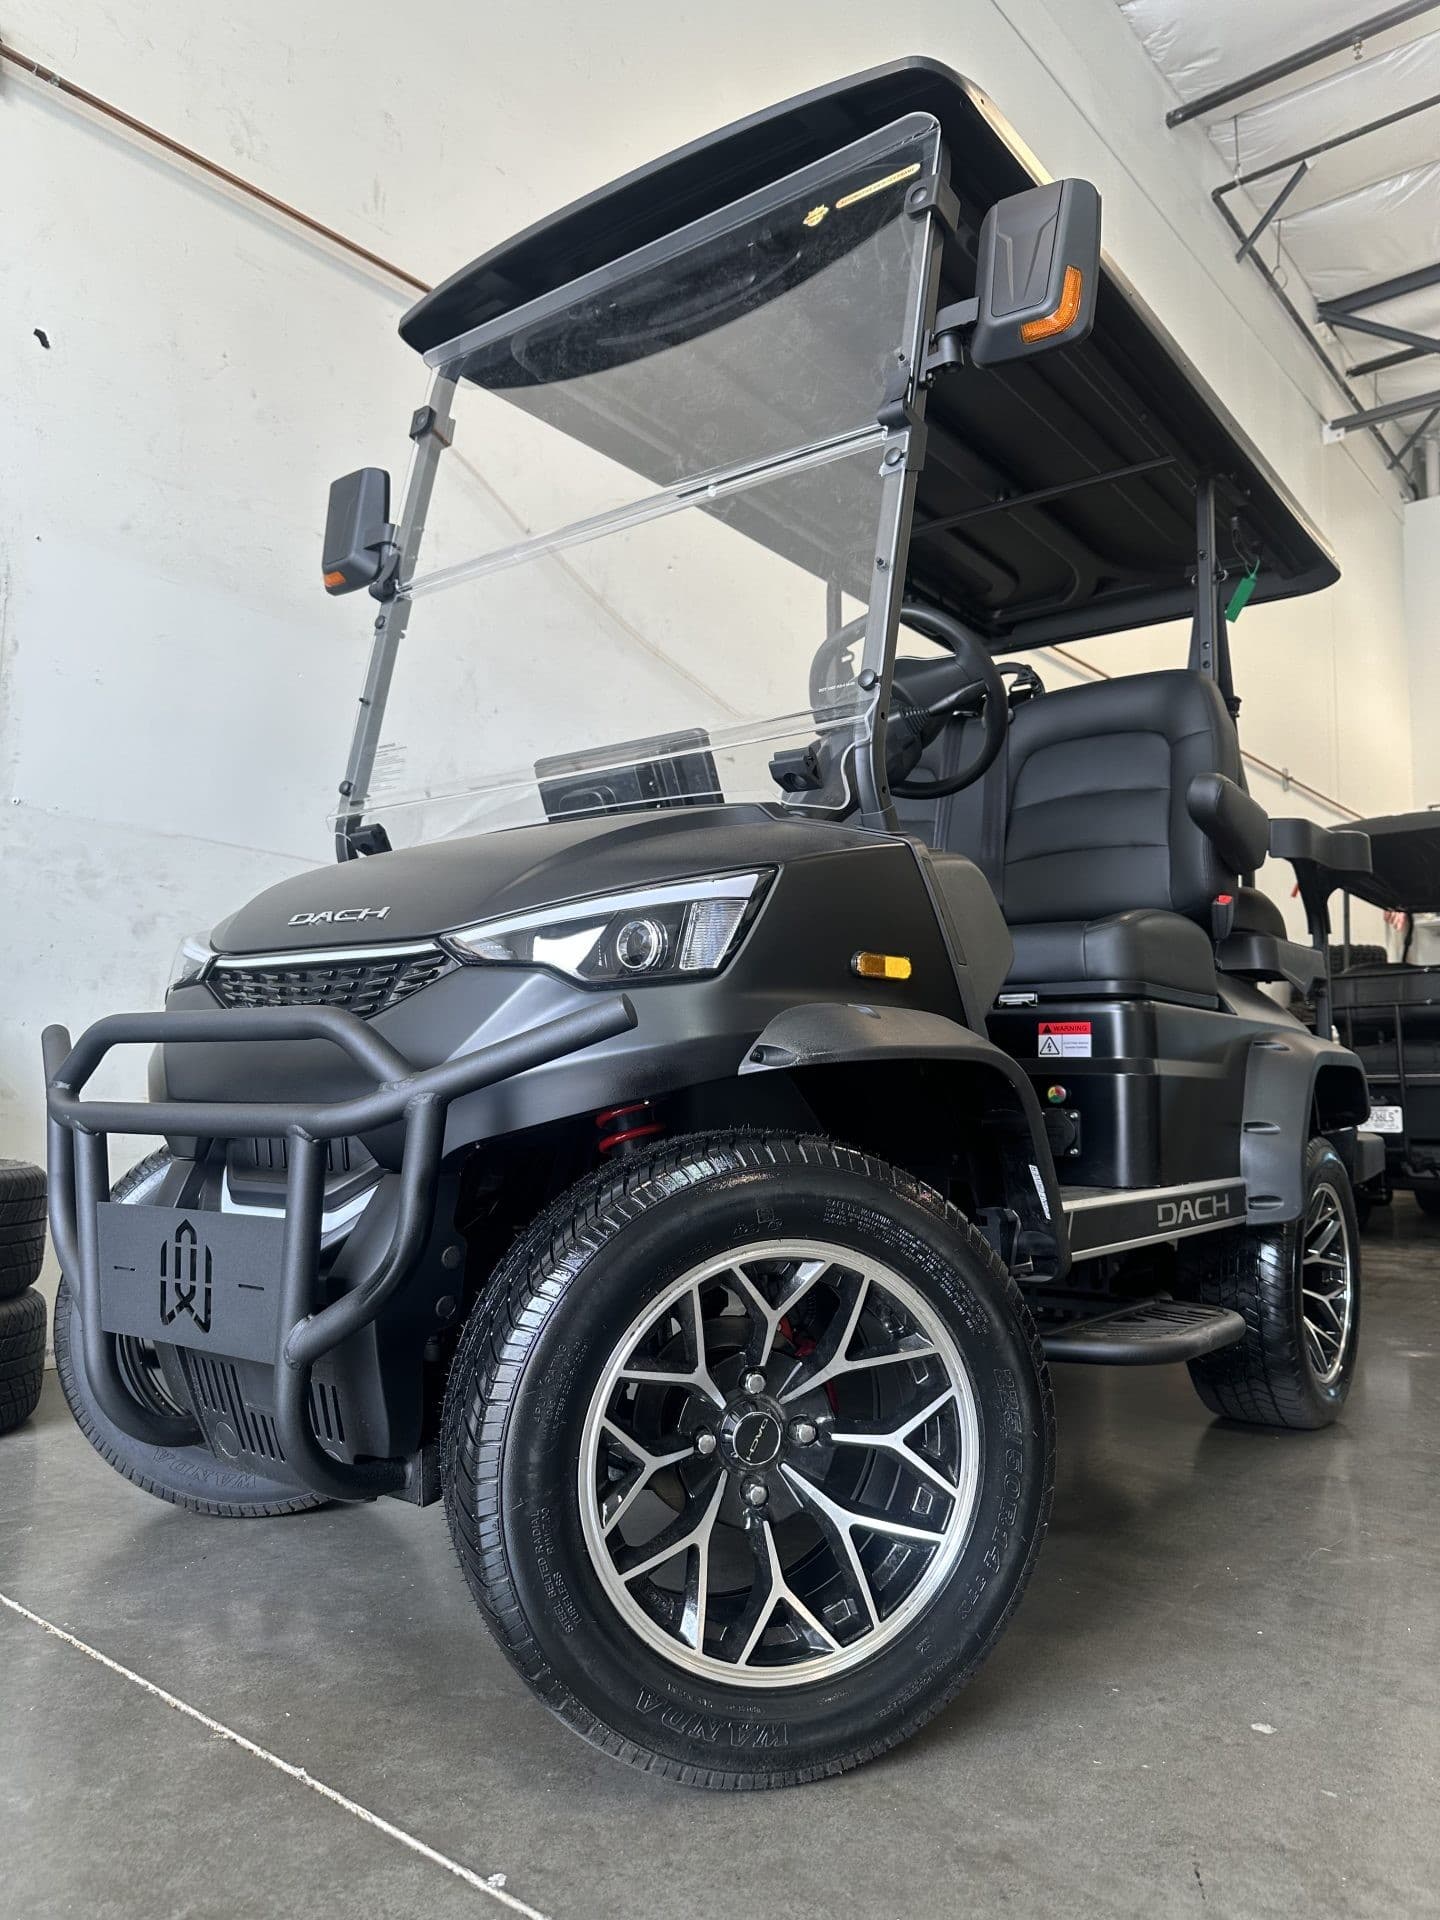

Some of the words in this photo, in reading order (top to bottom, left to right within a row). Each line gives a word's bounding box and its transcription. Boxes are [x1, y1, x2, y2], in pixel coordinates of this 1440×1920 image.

[288, 906, 391, 926] DACH
[1157, 1193, 1230, 1227] DACH
[746, 1418, 768, 1461] DACH
[153, 1447, 257, 1488] WANDA
[531, 1509, 544, 1554] RADIAL
[538, 1557, 557, 1599] BELTED
[552, 1600, 574, 1632] STEEL
[635, 1684, 789, 1748] WANDA
